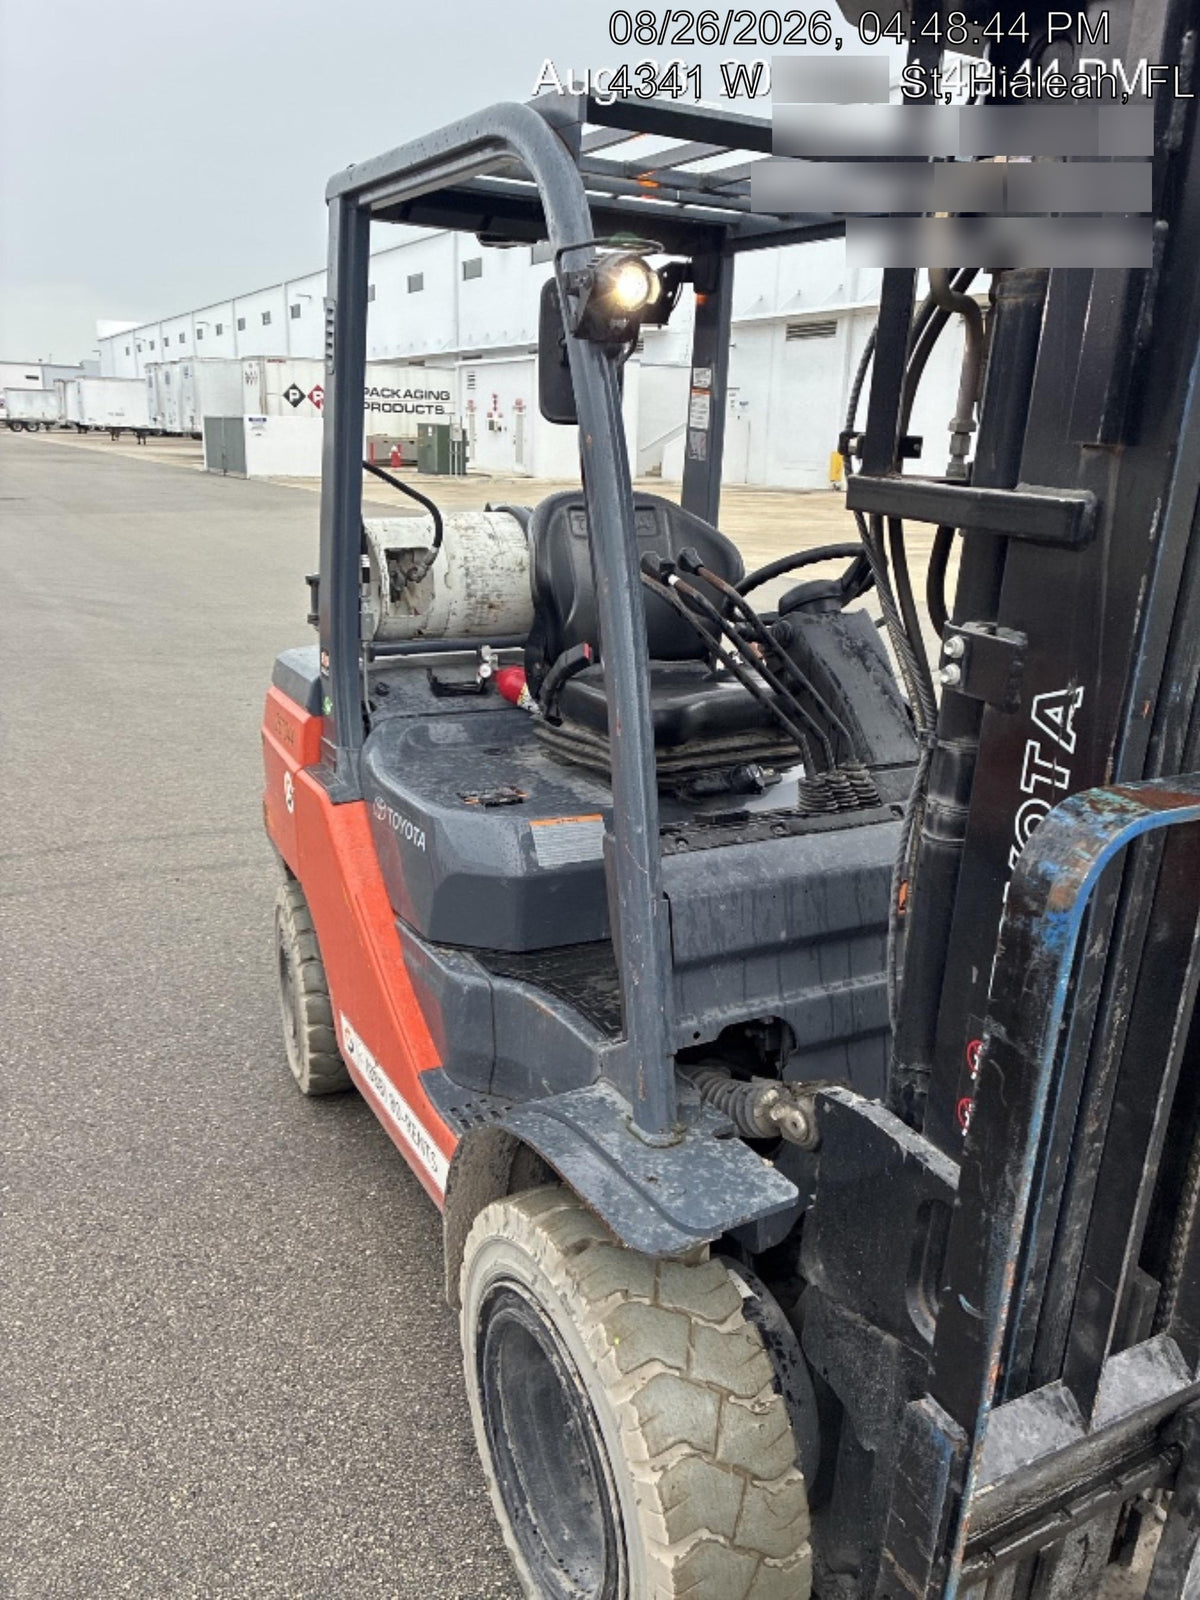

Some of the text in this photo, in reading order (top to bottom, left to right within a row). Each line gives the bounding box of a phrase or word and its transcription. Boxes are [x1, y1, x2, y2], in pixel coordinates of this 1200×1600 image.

[364, 387, 450, 401] PACKAGING
[364, 401, 445, 415] PRODUCTS
[387, 806, 426, 853] TOYOTA
